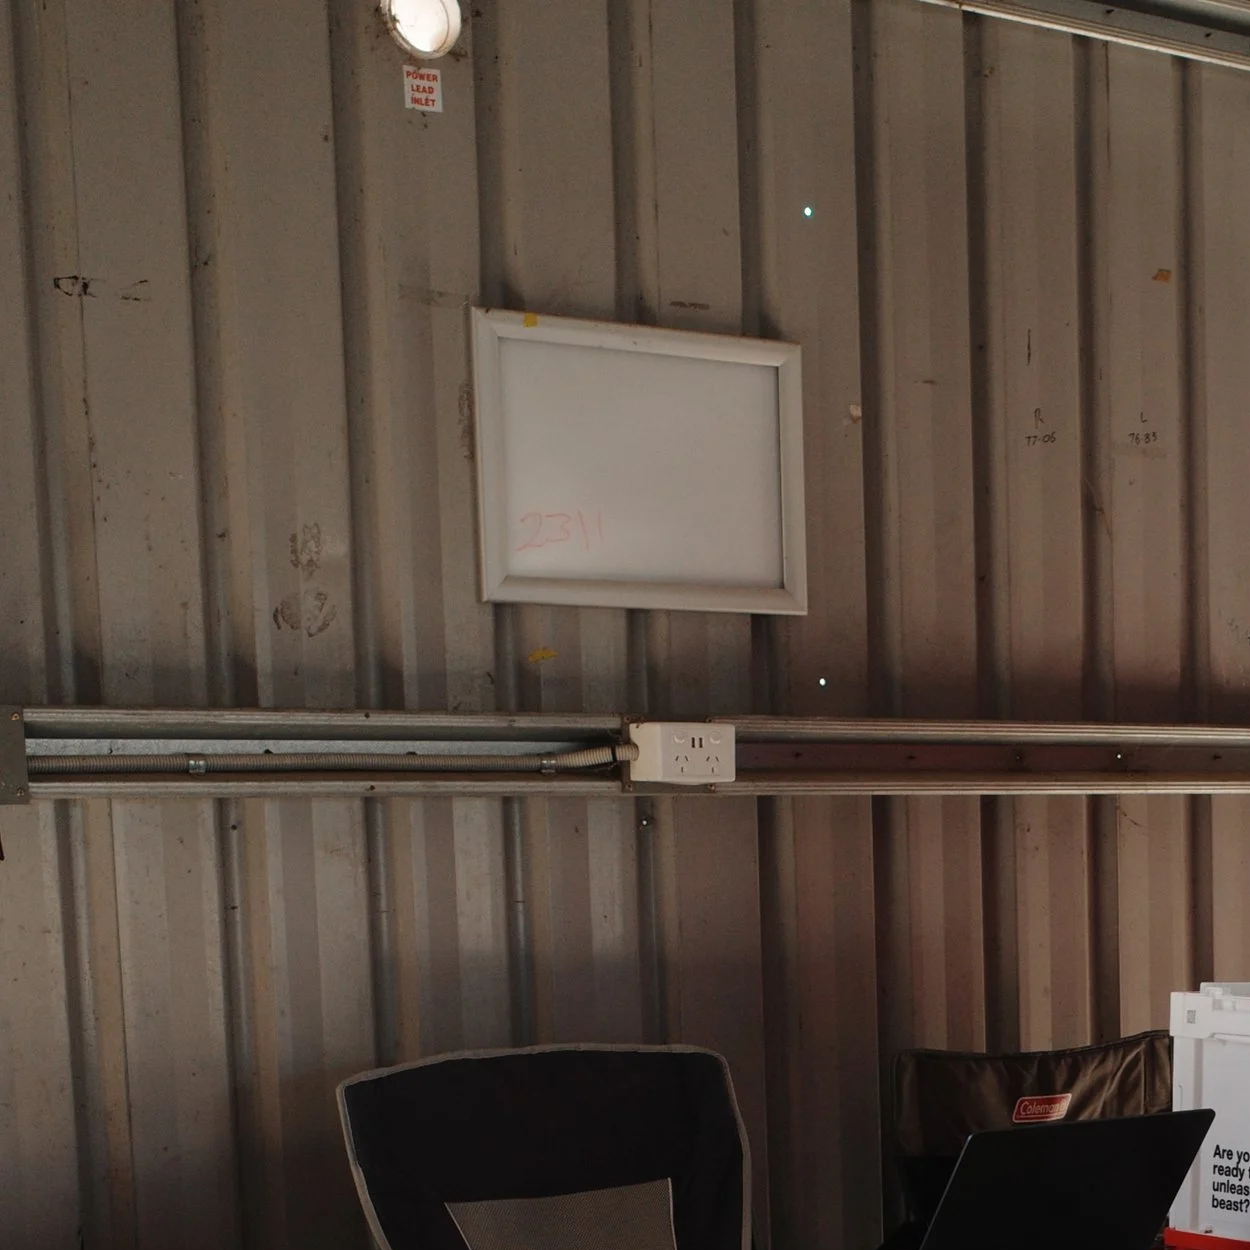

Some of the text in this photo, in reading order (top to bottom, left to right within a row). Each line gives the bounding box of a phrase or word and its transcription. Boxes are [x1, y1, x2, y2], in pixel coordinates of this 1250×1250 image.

[406, 71, 438, 82] POWER
[411, 84, 434, 94] LEAD
[411, 97, 436, 107] INLET
[1020, 1100, 1060, 1115] Coleman
[1213, 1144, 1234, 1160] Are
[1212, 1163, 1245, 1181] ready
[1211, 1194, 1250, 1213] beast?
